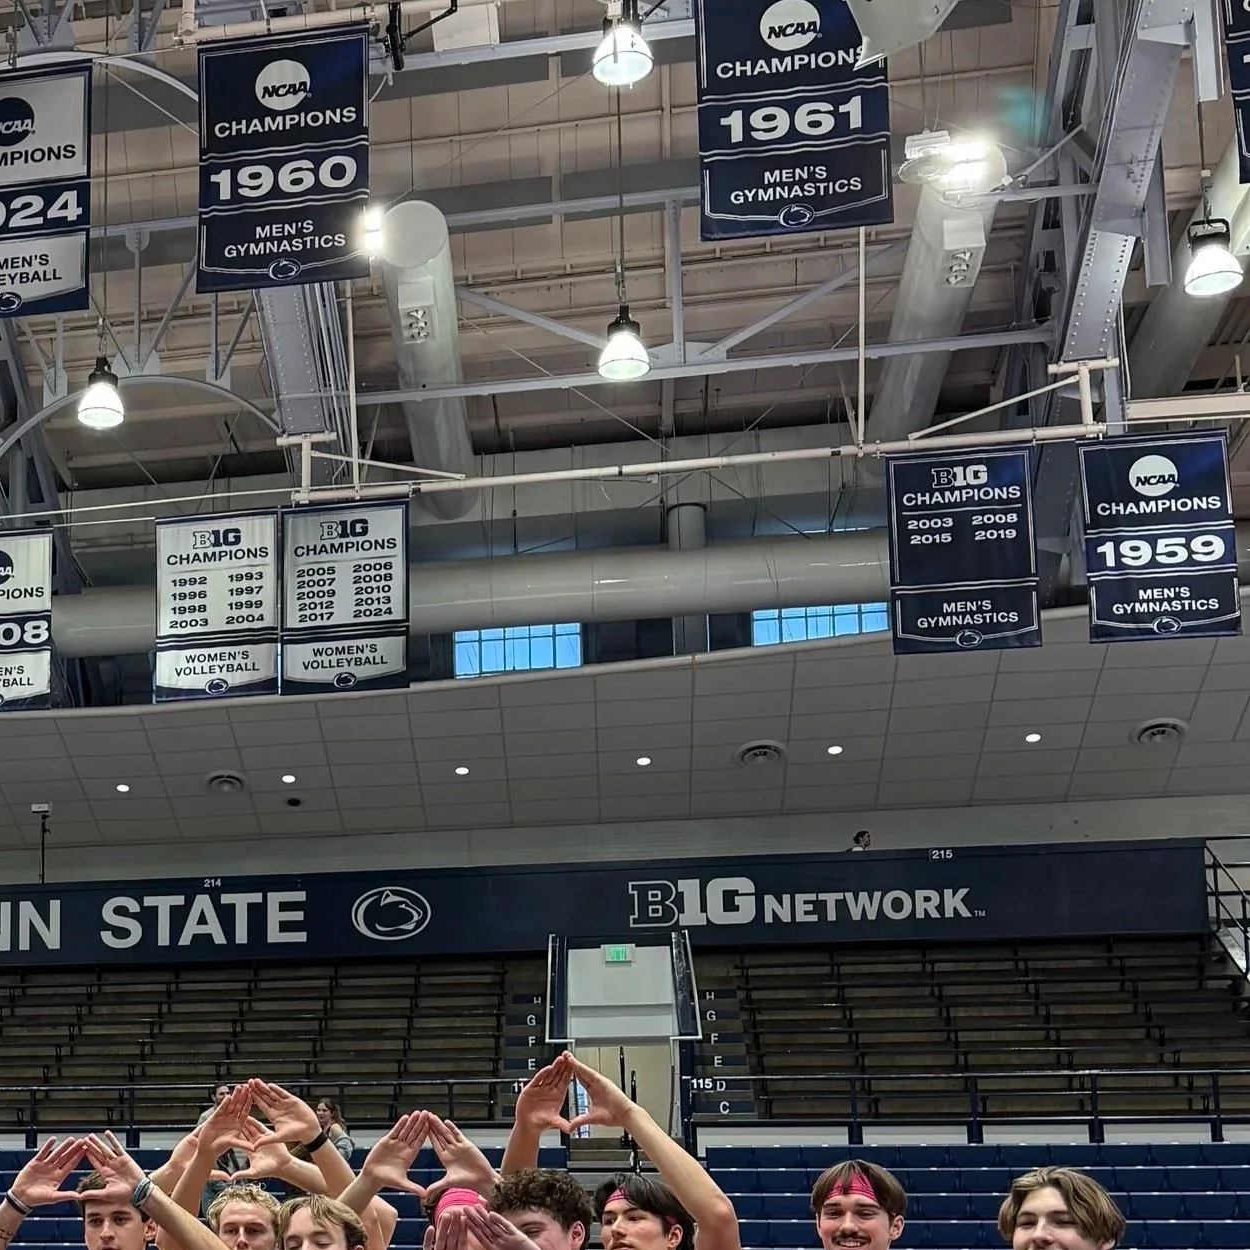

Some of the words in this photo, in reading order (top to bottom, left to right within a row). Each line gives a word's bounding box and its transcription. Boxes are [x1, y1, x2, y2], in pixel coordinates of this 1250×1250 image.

[767, 21, 820, 39] NCAA
[261, 81, 310, 99] NCAA
[214, 107, 357, 138] CHAMPIONS
[720, 96, 862, 144] 1961
[210, 155, 357, 200] 1960
[764, 166, 827, 184] MEN'S
[730, 177, 862, 204] GYMNASTICS
[256, 220, 314, 239] MEN'S
[224, 234, 346, 258] GYMNASTICS
[1135, 473, 1176, 487] NCAA
[902, 486, 1021, 507] CHAMPIONS
[1096, 496, 1222, 516] CHAMPIONS
[907, 517, 953, 530] 2003
[972, 513, 1018, 525] 2008
[910, 533, 952, 544] 2015
[975, 529, 1017, 541] 2019
[294, 538, 397, 557] CHAMPIONS
[1096, 535, 1225, 567] 1959
[167, 547, 269, 565] CHAMPIONS
[296, 566, 336, 578] 2005
[353, 562, 393, 573] 2006
[171, 577, 207, 587] 1992
[228, 571, 263, 583] 1993
[297, 578, 336, 589] 2007
[353, 573, 393, 584] 2008
[171, 591, 207, 601] 1996
[228, 586, 263, 597] 1997
[296, 589, 336, 600] 2009
[354, 584, 391, 595] 2010
[1138, 587, 1190, 600] MEN'S
[171, 604, 207, 615] 1998
[227, 600, 263, 611] 1999
[298, 601, 334, 612] 2012
[354, 596, 391, 607] 2013
[943, 600, 992, 613] MEN'S
[1112, 598, 1219, 614] GYMNASTICS
[169, 618, 209, 629] 2003
[225, 614, 264, 625] 2004
[299, 612, 334, 623] 2017
[353, 607, 393, 618] 2024
[917, 612, 1019, 629] GYMNASTICS
[185, 651, 250, 664] WOMEN'S
[312, 644, 377, 658] WOMEN'S
[175, 662, 260, 677] VOLLEYBALL
[302, 655, 388, 670] VOLLEYBALL
[931, 849, 953, 859] 215
[203, 878, 221, 888] 214
[764, 887, 972, 924] NETWORK
[100, 891, 308, 949] STATE
[691, 1079, 713, 1088] 115
